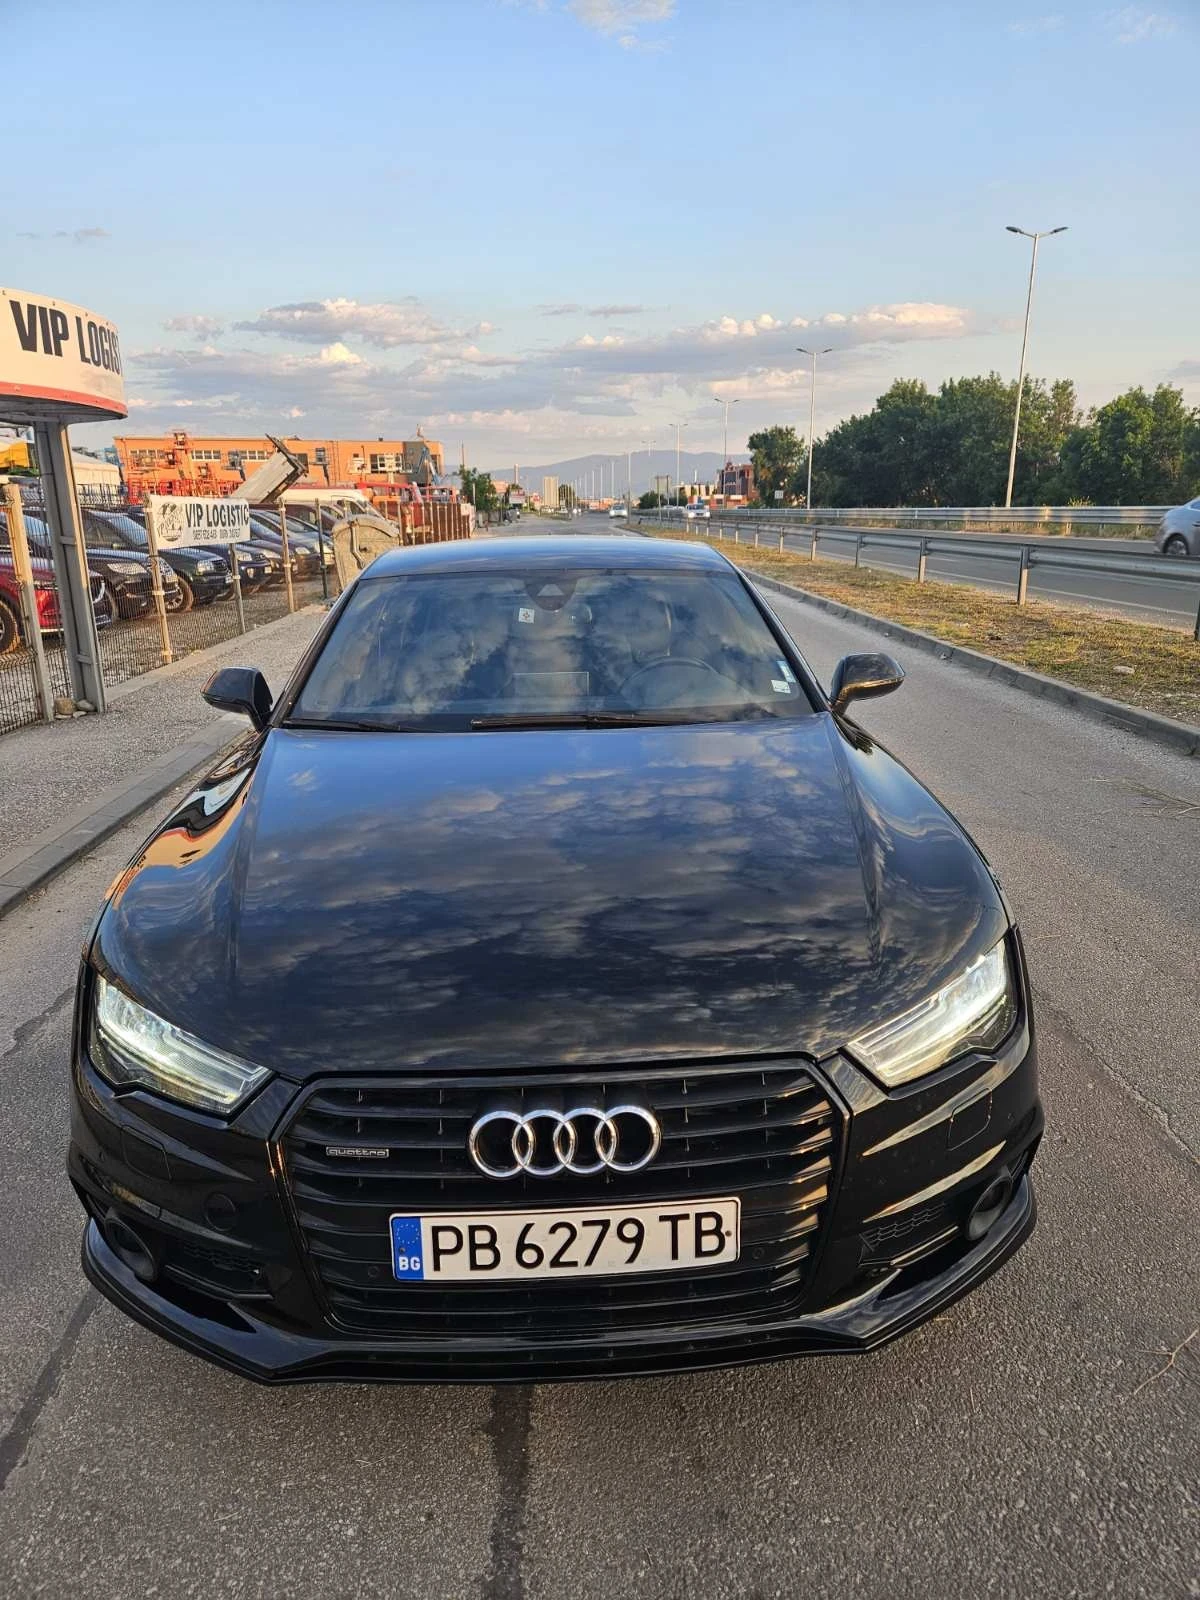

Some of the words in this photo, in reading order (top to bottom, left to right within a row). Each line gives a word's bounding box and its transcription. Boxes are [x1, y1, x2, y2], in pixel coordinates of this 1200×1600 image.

[9, 299, 69, 357] VIP
[185, 503, 203, 527] VIP
[206, 504, 249, 527] LOGISTIC
[328, 1148, 387, 1157] quattro
[431, 1224, 501, 1272] PB
[515, 1217, 645, 1269] 6279
[659, 1210, 726, 1261] TB
[398, 1255, 421, 1271] BG
